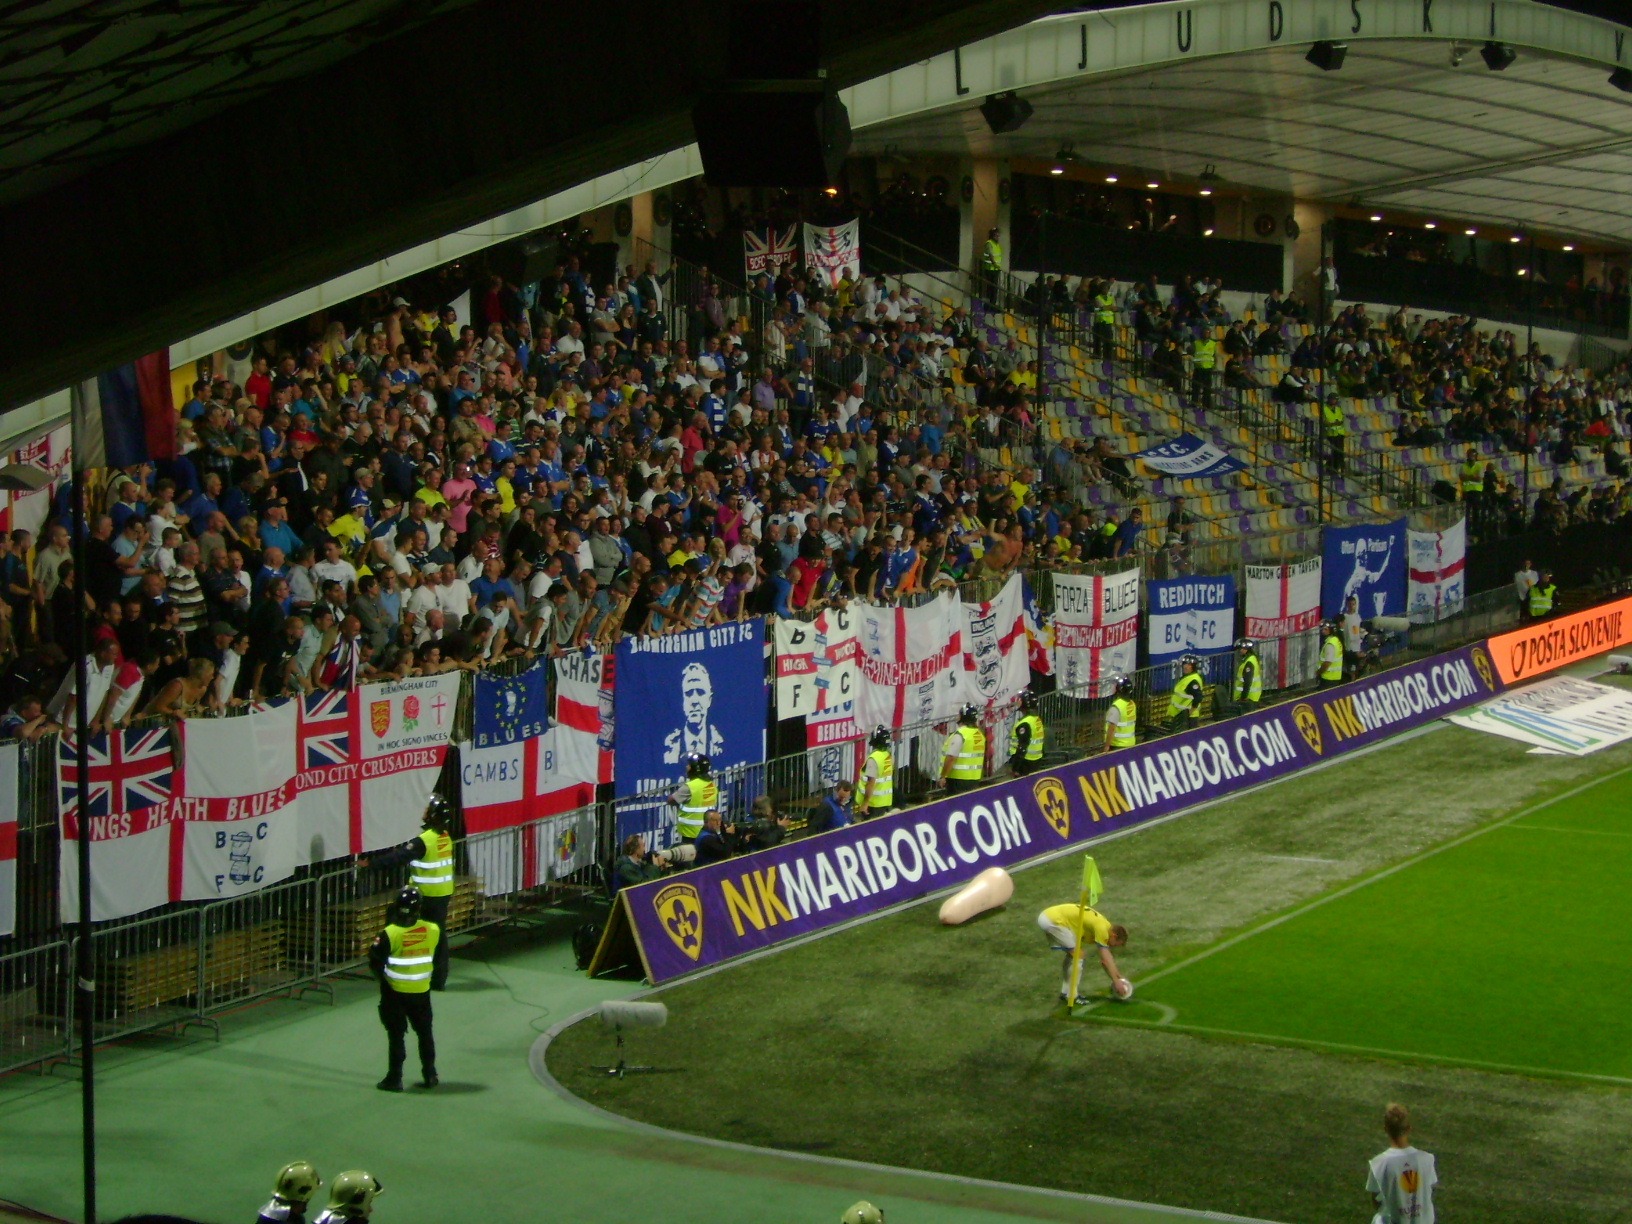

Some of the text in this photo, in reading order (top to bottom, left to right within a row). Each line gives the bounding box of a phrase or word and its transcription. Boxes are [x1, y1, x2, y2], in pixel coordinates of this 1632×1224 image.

[1055, 578, 1138, 614] FORZA BLUES
[1159, 583, 1225, 609] REDDITCH
[709, 626, 736, 649] CITY
[738, 623, 753, 642] FC
[1106, 622, 1125, 646] CITY
[1165, 620, 1217, 644] BC FC
[1528, 610, 1623, 670] POŠTA SLOVENIJE
[560, 654, 614, 685] CHASE
[380, 679, 439, 696] BIRMINGHAM CITY
[792, 684, 802, 709] F
[1323, 658, 1477, 743] NKMARIBOR.COM
[377, 732, 448, 752] IN HOC SIGNO VINCES
[478, 721, 542, 746] BLUES
[328, 763, 359, 783] CITY
[361, 749, 437, 778] CRUSADERS
[462, 758, 519, 786] CAMBS
[1078, 718, 1297, 823] NKMARIBOR.COM
[147, 796, 208, 830] HEATH
[226, 784, 287, 821] BLUES
[720, 796, 1032, 937] NKMARIBOR.COM
